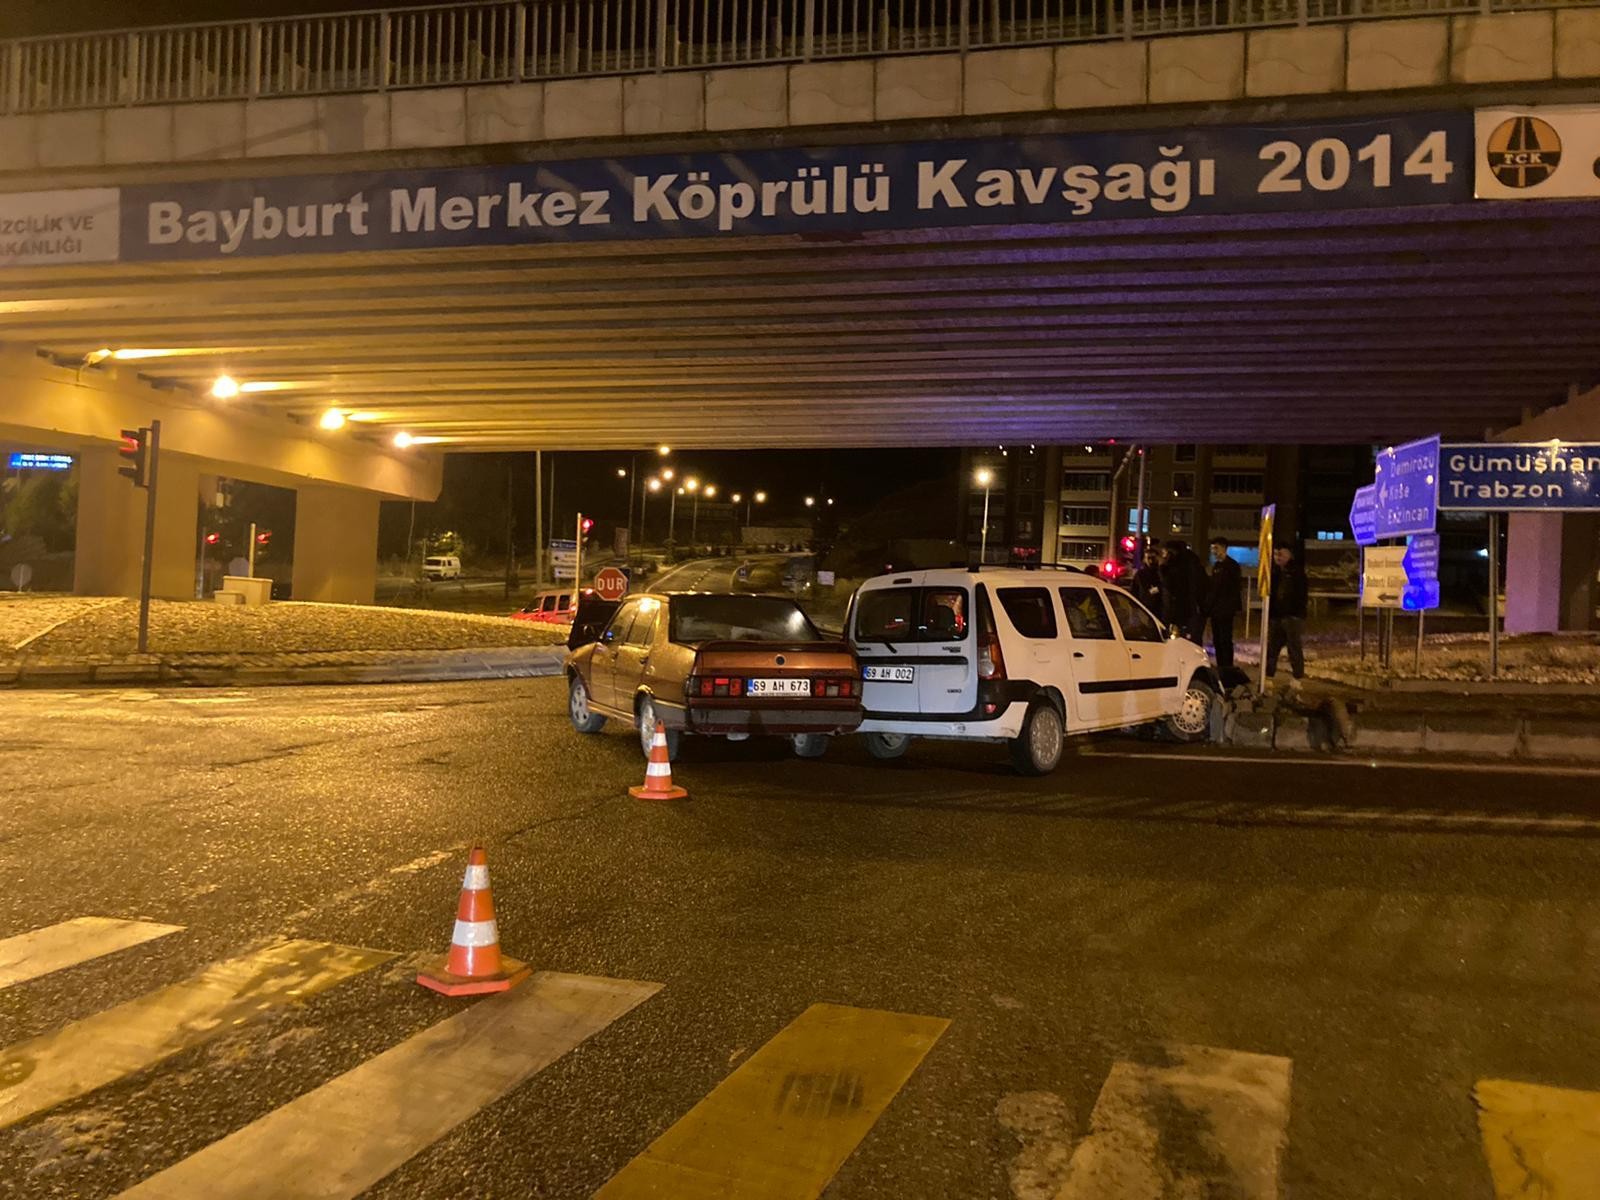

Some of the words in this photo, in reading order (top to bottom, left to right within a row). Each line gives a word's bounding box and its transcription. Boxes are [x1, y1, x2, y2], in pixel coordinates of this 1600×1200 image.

[1504, 153, 1542, 165] TCK
[148, 191, 369, 254] Bayburt
[390, 182, 611, 233] Merkez
[633, 163, 890, 231] Köprülü
[917, 145, 1216, 216] Kavşağı
[1257, 130, 1454, 193] 2014
[0, 214, 63, 235] ZCİLİK
[69, 215, 94, 232] VE
[1449, 453, 1600, 474] Gümüşhan
[1449, 480, 1563, 498] Trabzon
[597, 577, 624, 591] DUR
[866, 668, 877, 678] 69
[880, 668, 891, 678] AH
[895, 668, 912, 680] 002
[753, 680, 766, 691] 69
[772, 680, 785, 691] AH
[790, 680, 809, 692] 673
